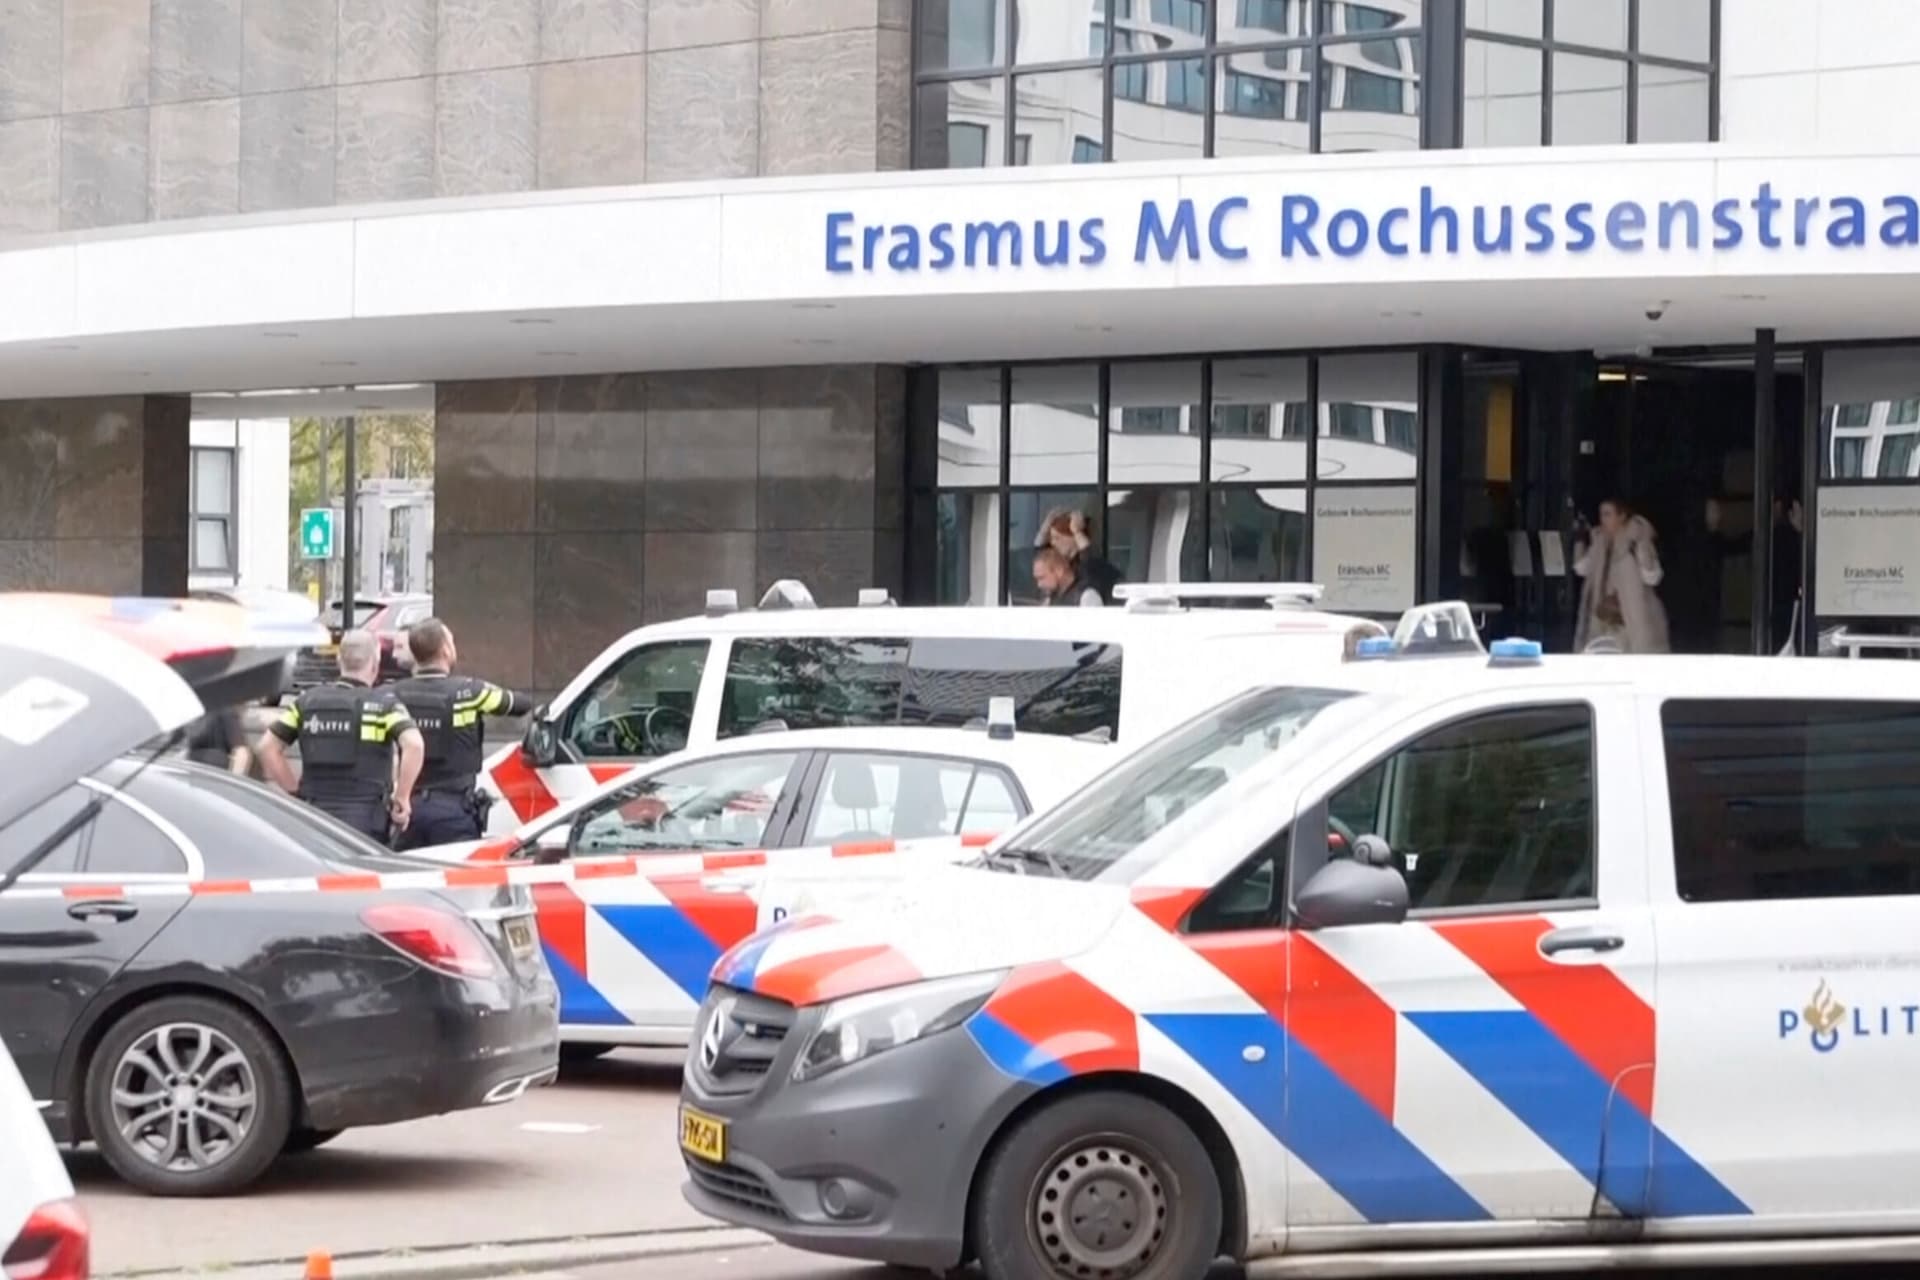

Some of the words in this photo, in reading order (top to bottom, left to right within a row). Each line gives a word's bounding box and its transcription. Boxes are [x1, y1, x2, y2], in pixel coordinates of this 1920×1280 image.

[825, 212, 1107, 272] Erasmus
[1134, 196, 1248, 262] MC
[1280, 181, 1920, 258] Rochussenstraa
[1337, 564, 1376, 575] Erasmus
[1843, 567, 1887, 578] Erasmus
